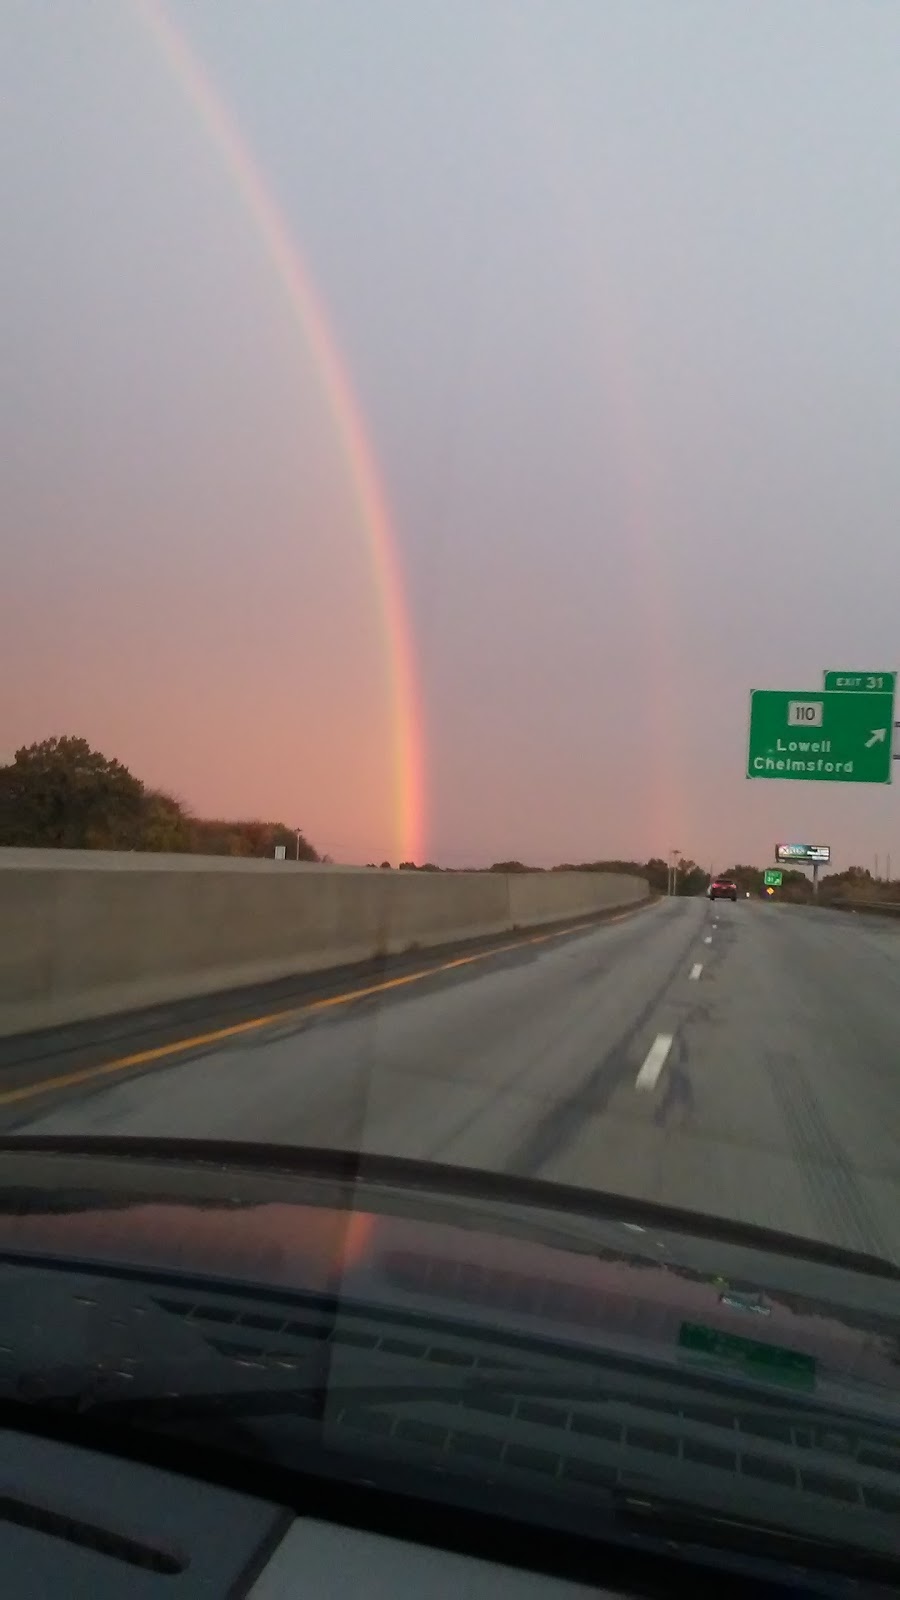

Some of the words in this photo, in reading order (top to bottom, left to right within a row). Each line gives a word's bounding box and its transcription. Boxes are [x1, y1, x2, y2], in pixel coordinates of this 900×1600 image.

[836, 677, 862, 687] EXIT
[865, 676, 884, 689] 31
[795, 706, 816, 721] 110
[776, 738, 831, 753] Lowell
[753, 757, 854, 773] Chelmsford
